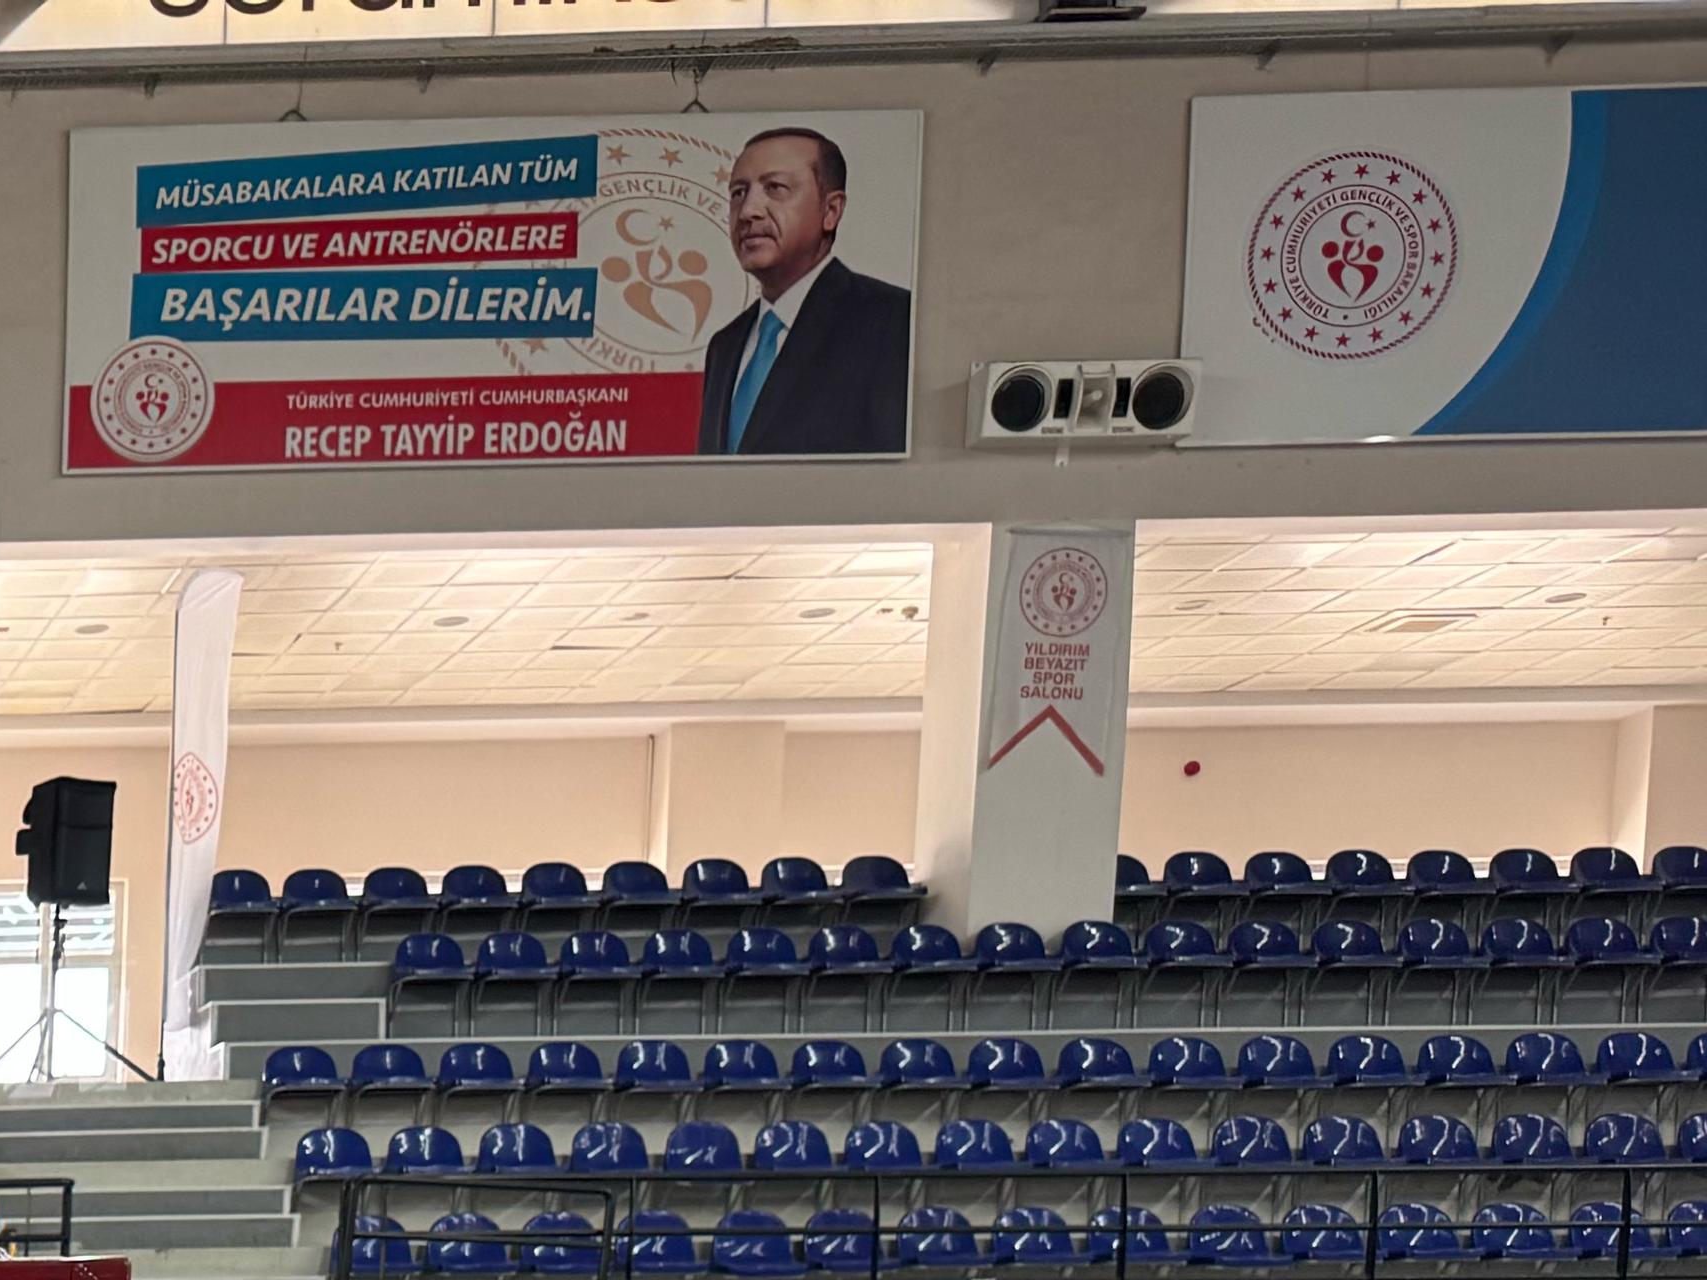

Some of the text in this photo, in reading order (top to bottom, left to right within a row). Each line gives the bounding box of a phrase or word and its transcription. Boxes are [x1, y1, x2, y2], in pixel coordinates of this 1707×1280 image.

[155, 154, 579, 210] MÜSABAKALARA KATILAN TÜM
[1395, 206, 1411, 225] VE
[151, 220, 567, 265] SPORCU VE ANTRENÖRLERE
[160, 276, 593, 331] BAŞARILAR DİLERİM.
[287, 386, 629, 410] TÜRKİYE CUMHURİYETİ CUMHURBAŞKANI
[285, 410, 628, 458] RECEP TAYYİP ERDOĞAN
[1025, 641, 1091, 657] YILDIRIM
[1024, 656, 1088, 672] BEYAZIT
[1032, 671, 1076, 686] SPOR
[1019, 685, 1084, 701] SALONU
